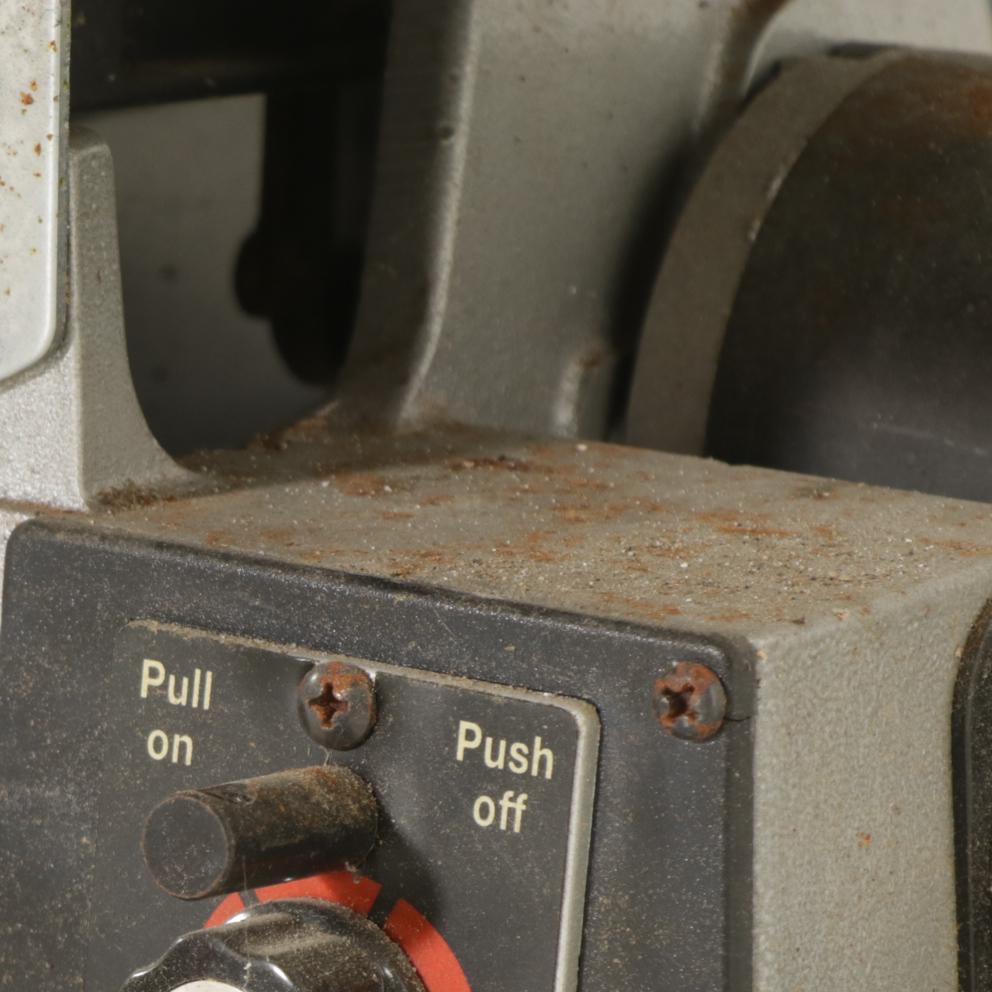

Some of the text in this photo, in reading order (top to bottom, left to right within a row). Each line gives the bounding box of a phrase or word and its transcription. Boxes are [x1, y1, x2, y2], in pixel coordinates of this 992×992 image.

[140, 659, 213, 710] Pull
[147, 728, 193, 766] on
[456, 720, 554, 779] Push
[472, 790, 528, 832] off
